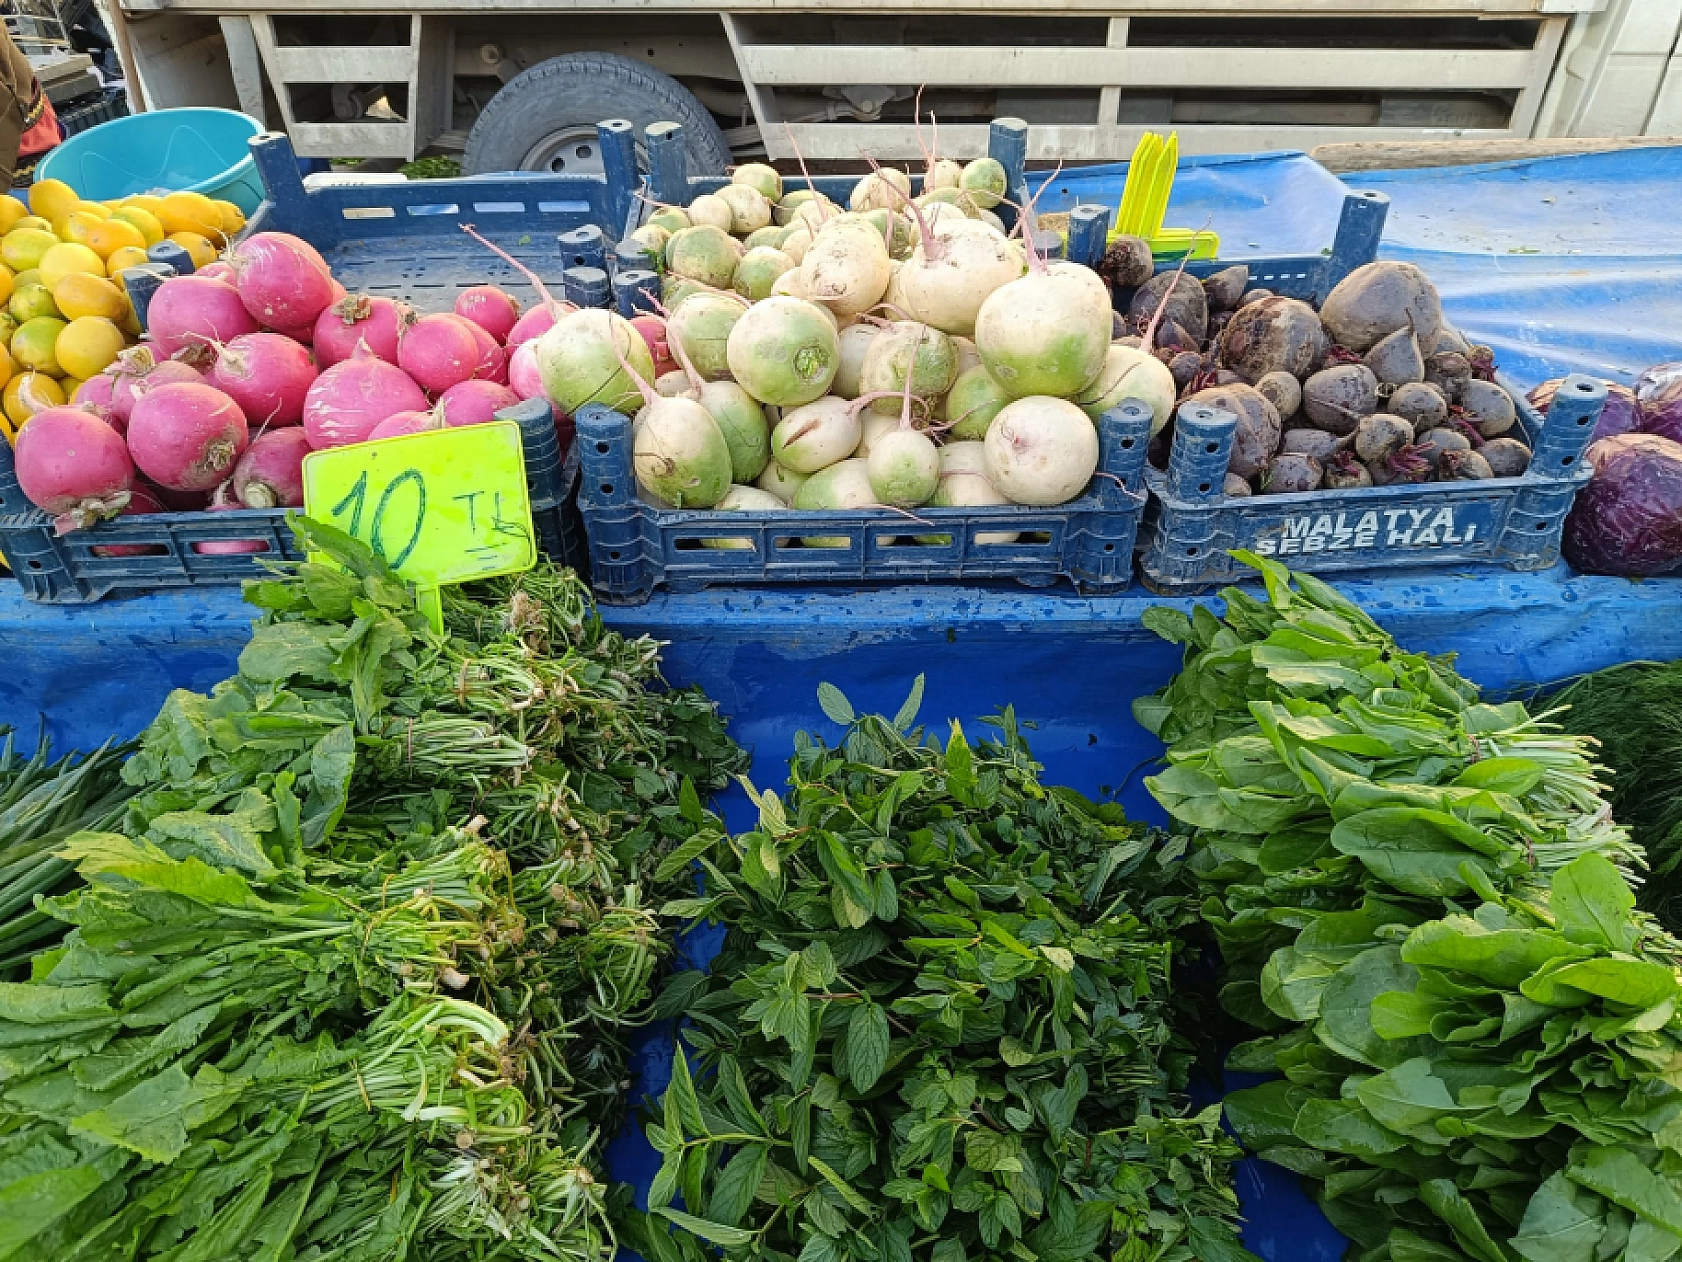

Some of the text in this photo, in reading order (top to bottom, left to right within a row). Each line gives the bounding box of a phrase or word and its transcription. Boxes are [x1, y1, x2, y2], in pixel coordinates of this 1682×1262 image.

[331, 468, 426, 573] 10
[1282, 507, 1453, 538] MALATYA
[1254, 531, 1375, 555] SEBZE
